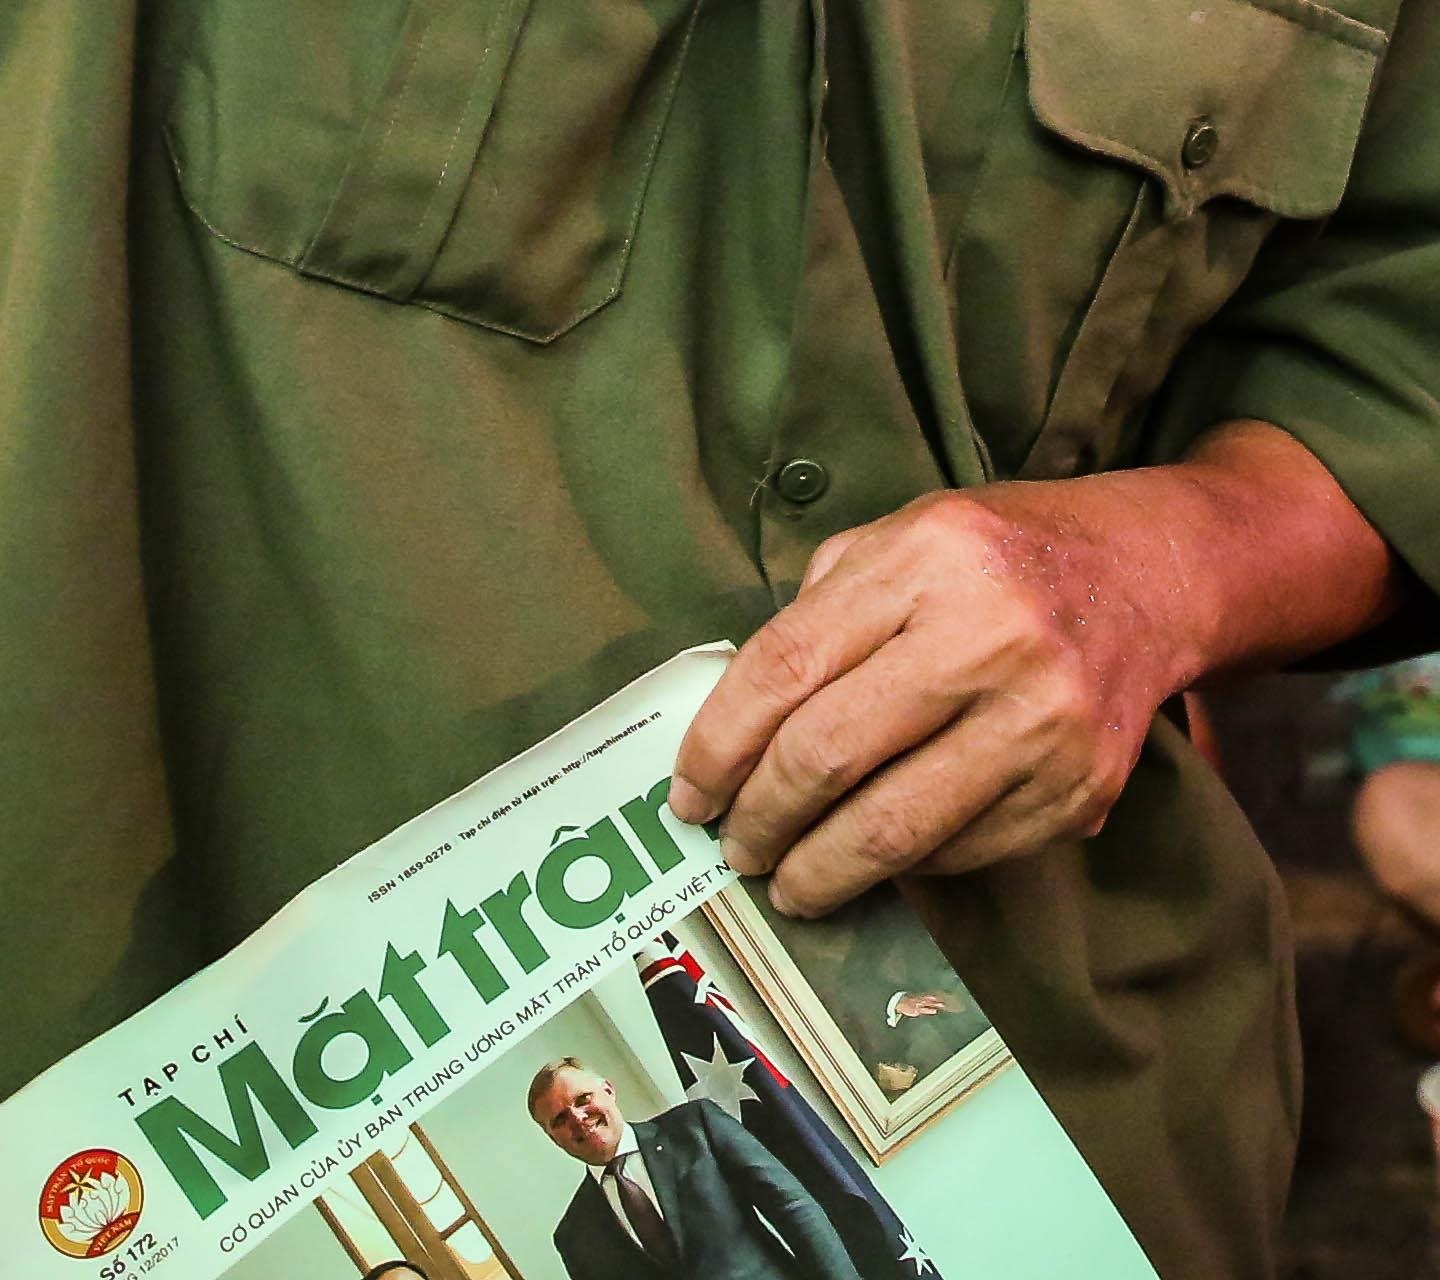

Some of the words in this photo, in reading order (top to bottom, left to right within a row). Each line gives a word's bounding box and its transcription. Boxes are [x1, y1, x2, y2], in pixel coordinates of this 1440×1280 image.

[367, 879, 397, 904] ISSN
[397, 842, 454, 882] 1859-0276
[561, 710, 663, 775] http://tapchimattran.vn
[117, 1061, 180, 1108] TẠP
[191, 1013, 250, 1064] CHÍ
[134, 939, 452, 1221] Mặt
[219, 1222, 249, 1254] CƠ
[248, 1184, 301, 1230] QUAN
[300, 1155, 340, 1189] CỦA
[337, 1132, 364, 1159] ỦY
[364, 1104, 404, 1140] BAN
[402, 1058, 465, 1109] TRUNG
[464, 1019, 516, 1063] ƯƠNG
[516, 990, 553, 1025] MẶT
[552, 954, 602, 995] TRẬN
[600, 930, 627, 959] TỔ
[626, 898, 677, 941] QUỐC
[675, 870, 713, 903] VIỆT
[100, 1253, 126, 1280] Số
[126, 1233, 158, 1261] 172
[139, 1236, 180, 1274] 12/2017
